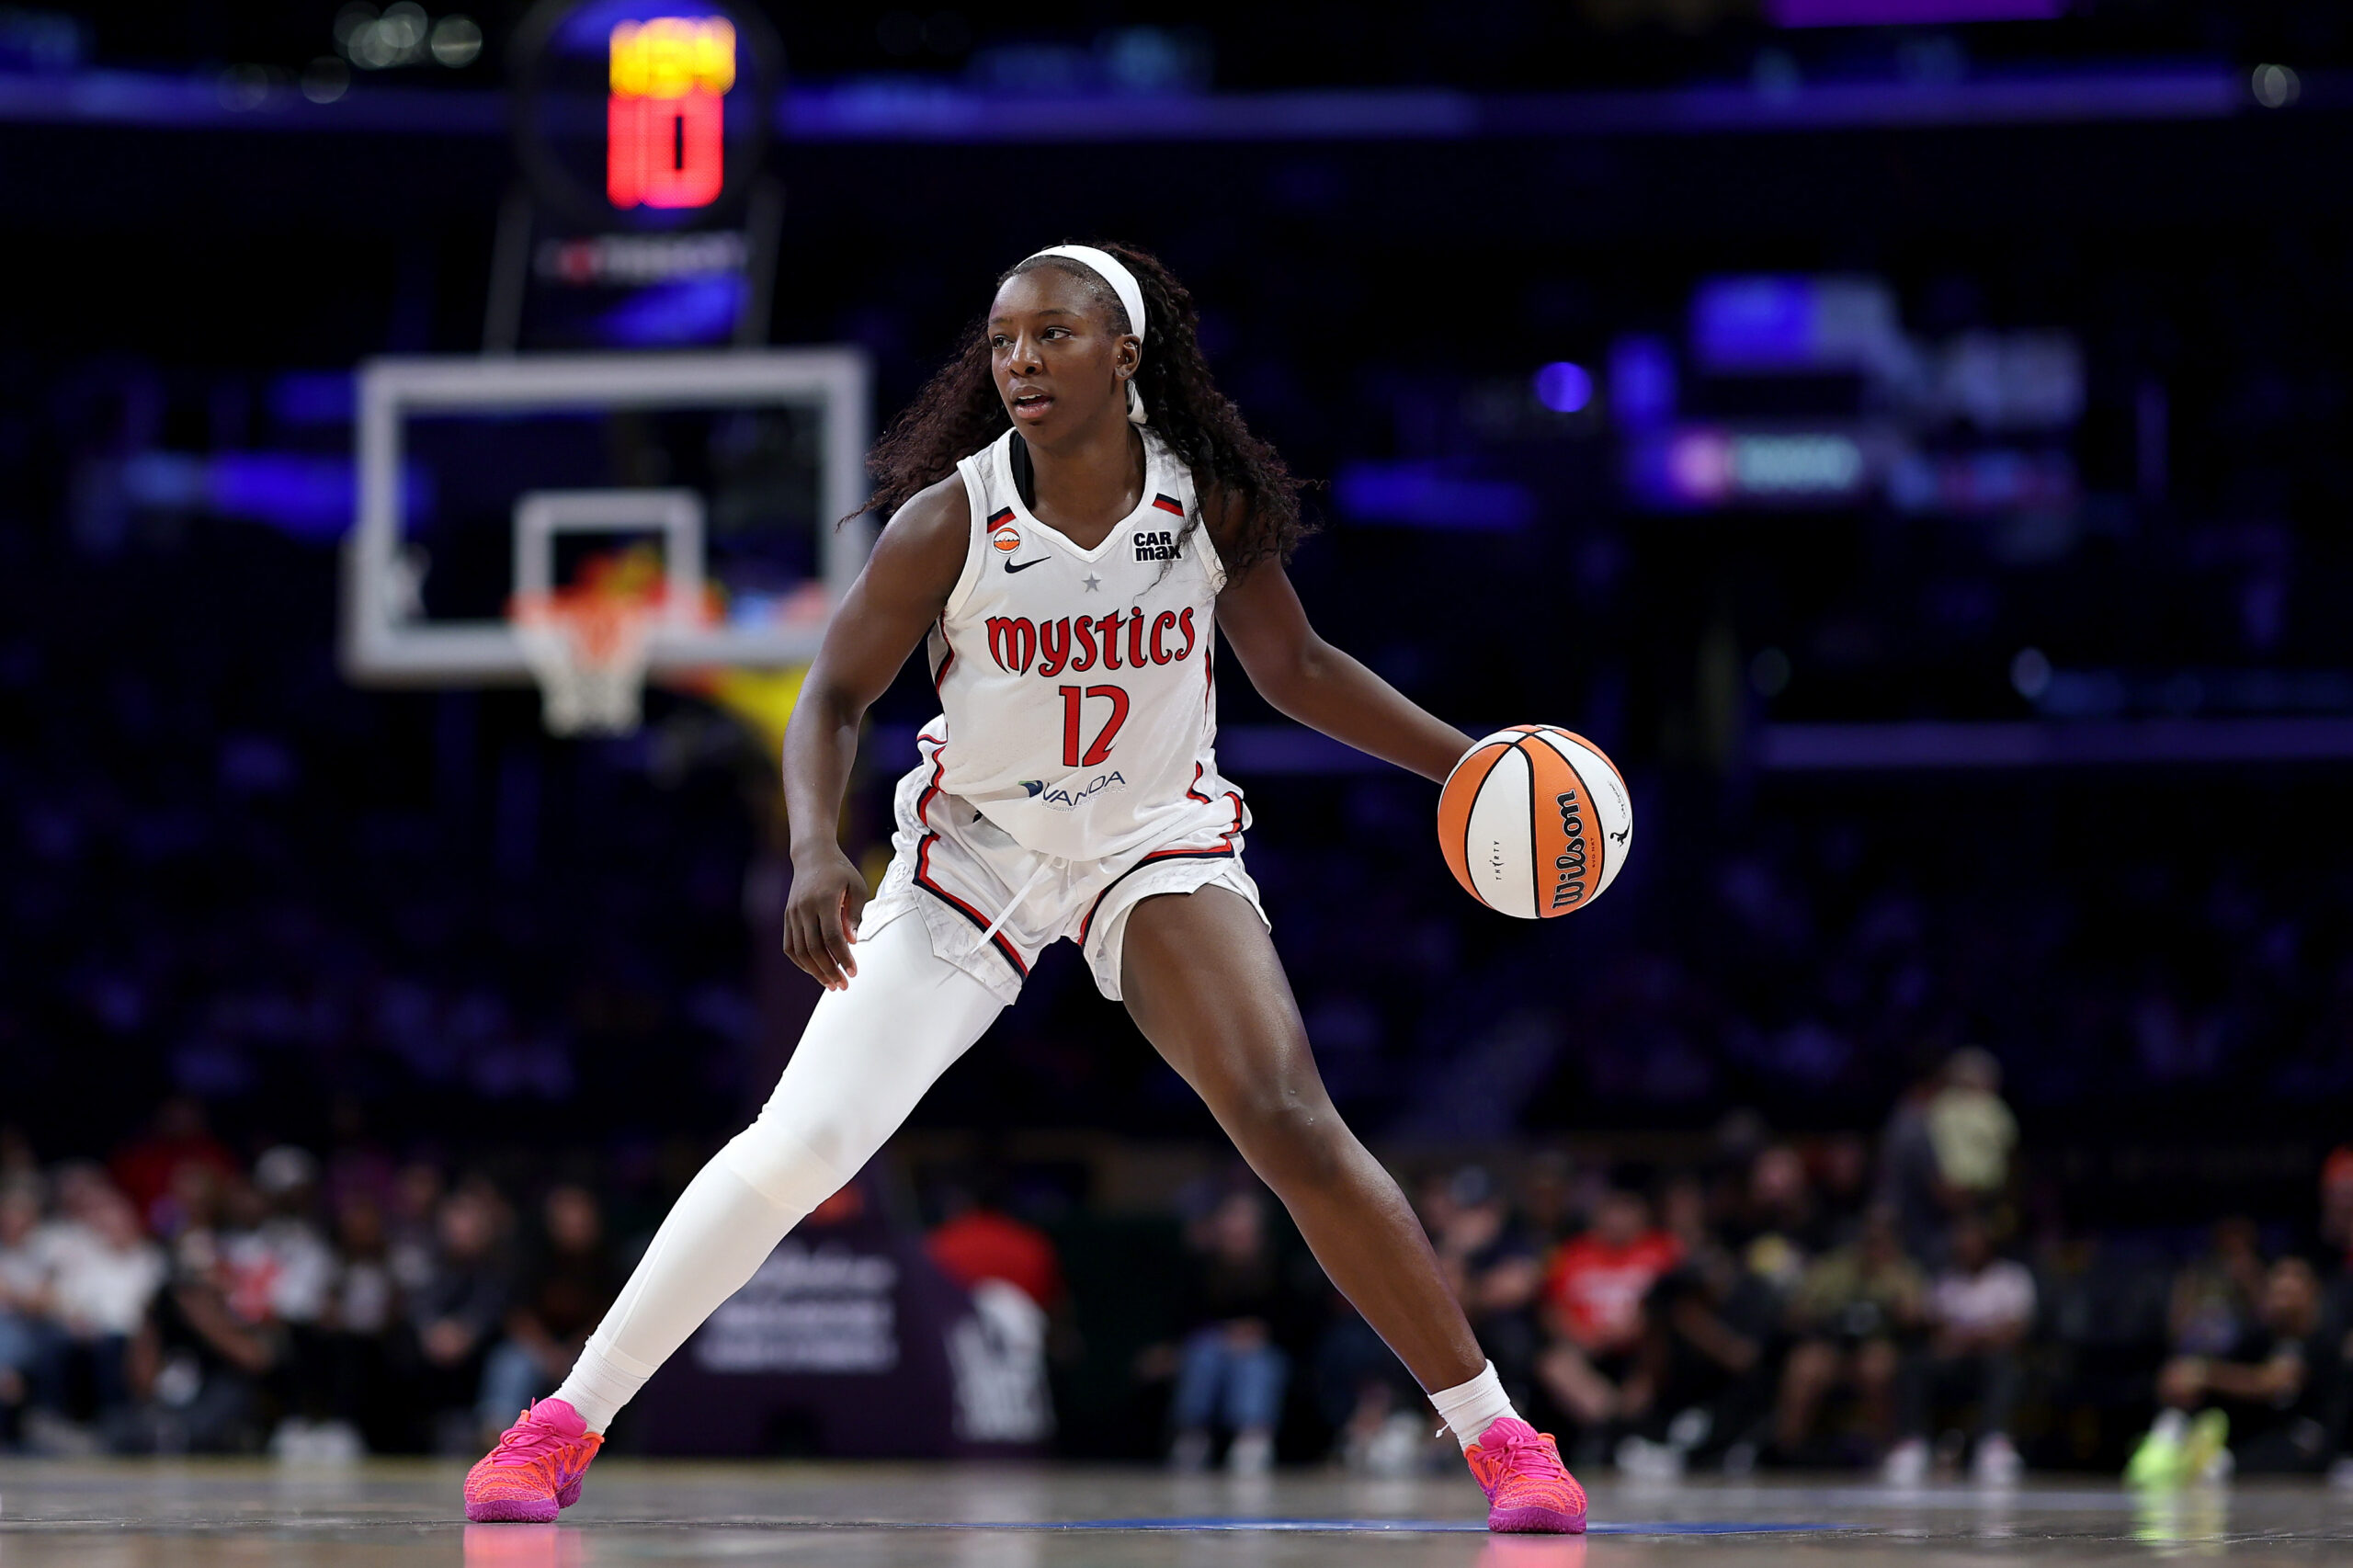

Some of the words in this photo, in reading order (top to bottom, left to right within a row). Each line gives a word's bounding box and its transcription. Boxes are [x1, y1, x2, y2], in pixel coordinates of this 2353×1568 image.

[1133, 531, 1172, 547] CAR
[1135, 545, 1182, 562] max
[985, 606, 1195, 677] mystics
[1059, 684, 1130, 767] 12
[1043, 770, 1126, 806] VANDA
[1552, 789, 1587, 910] Wilson
